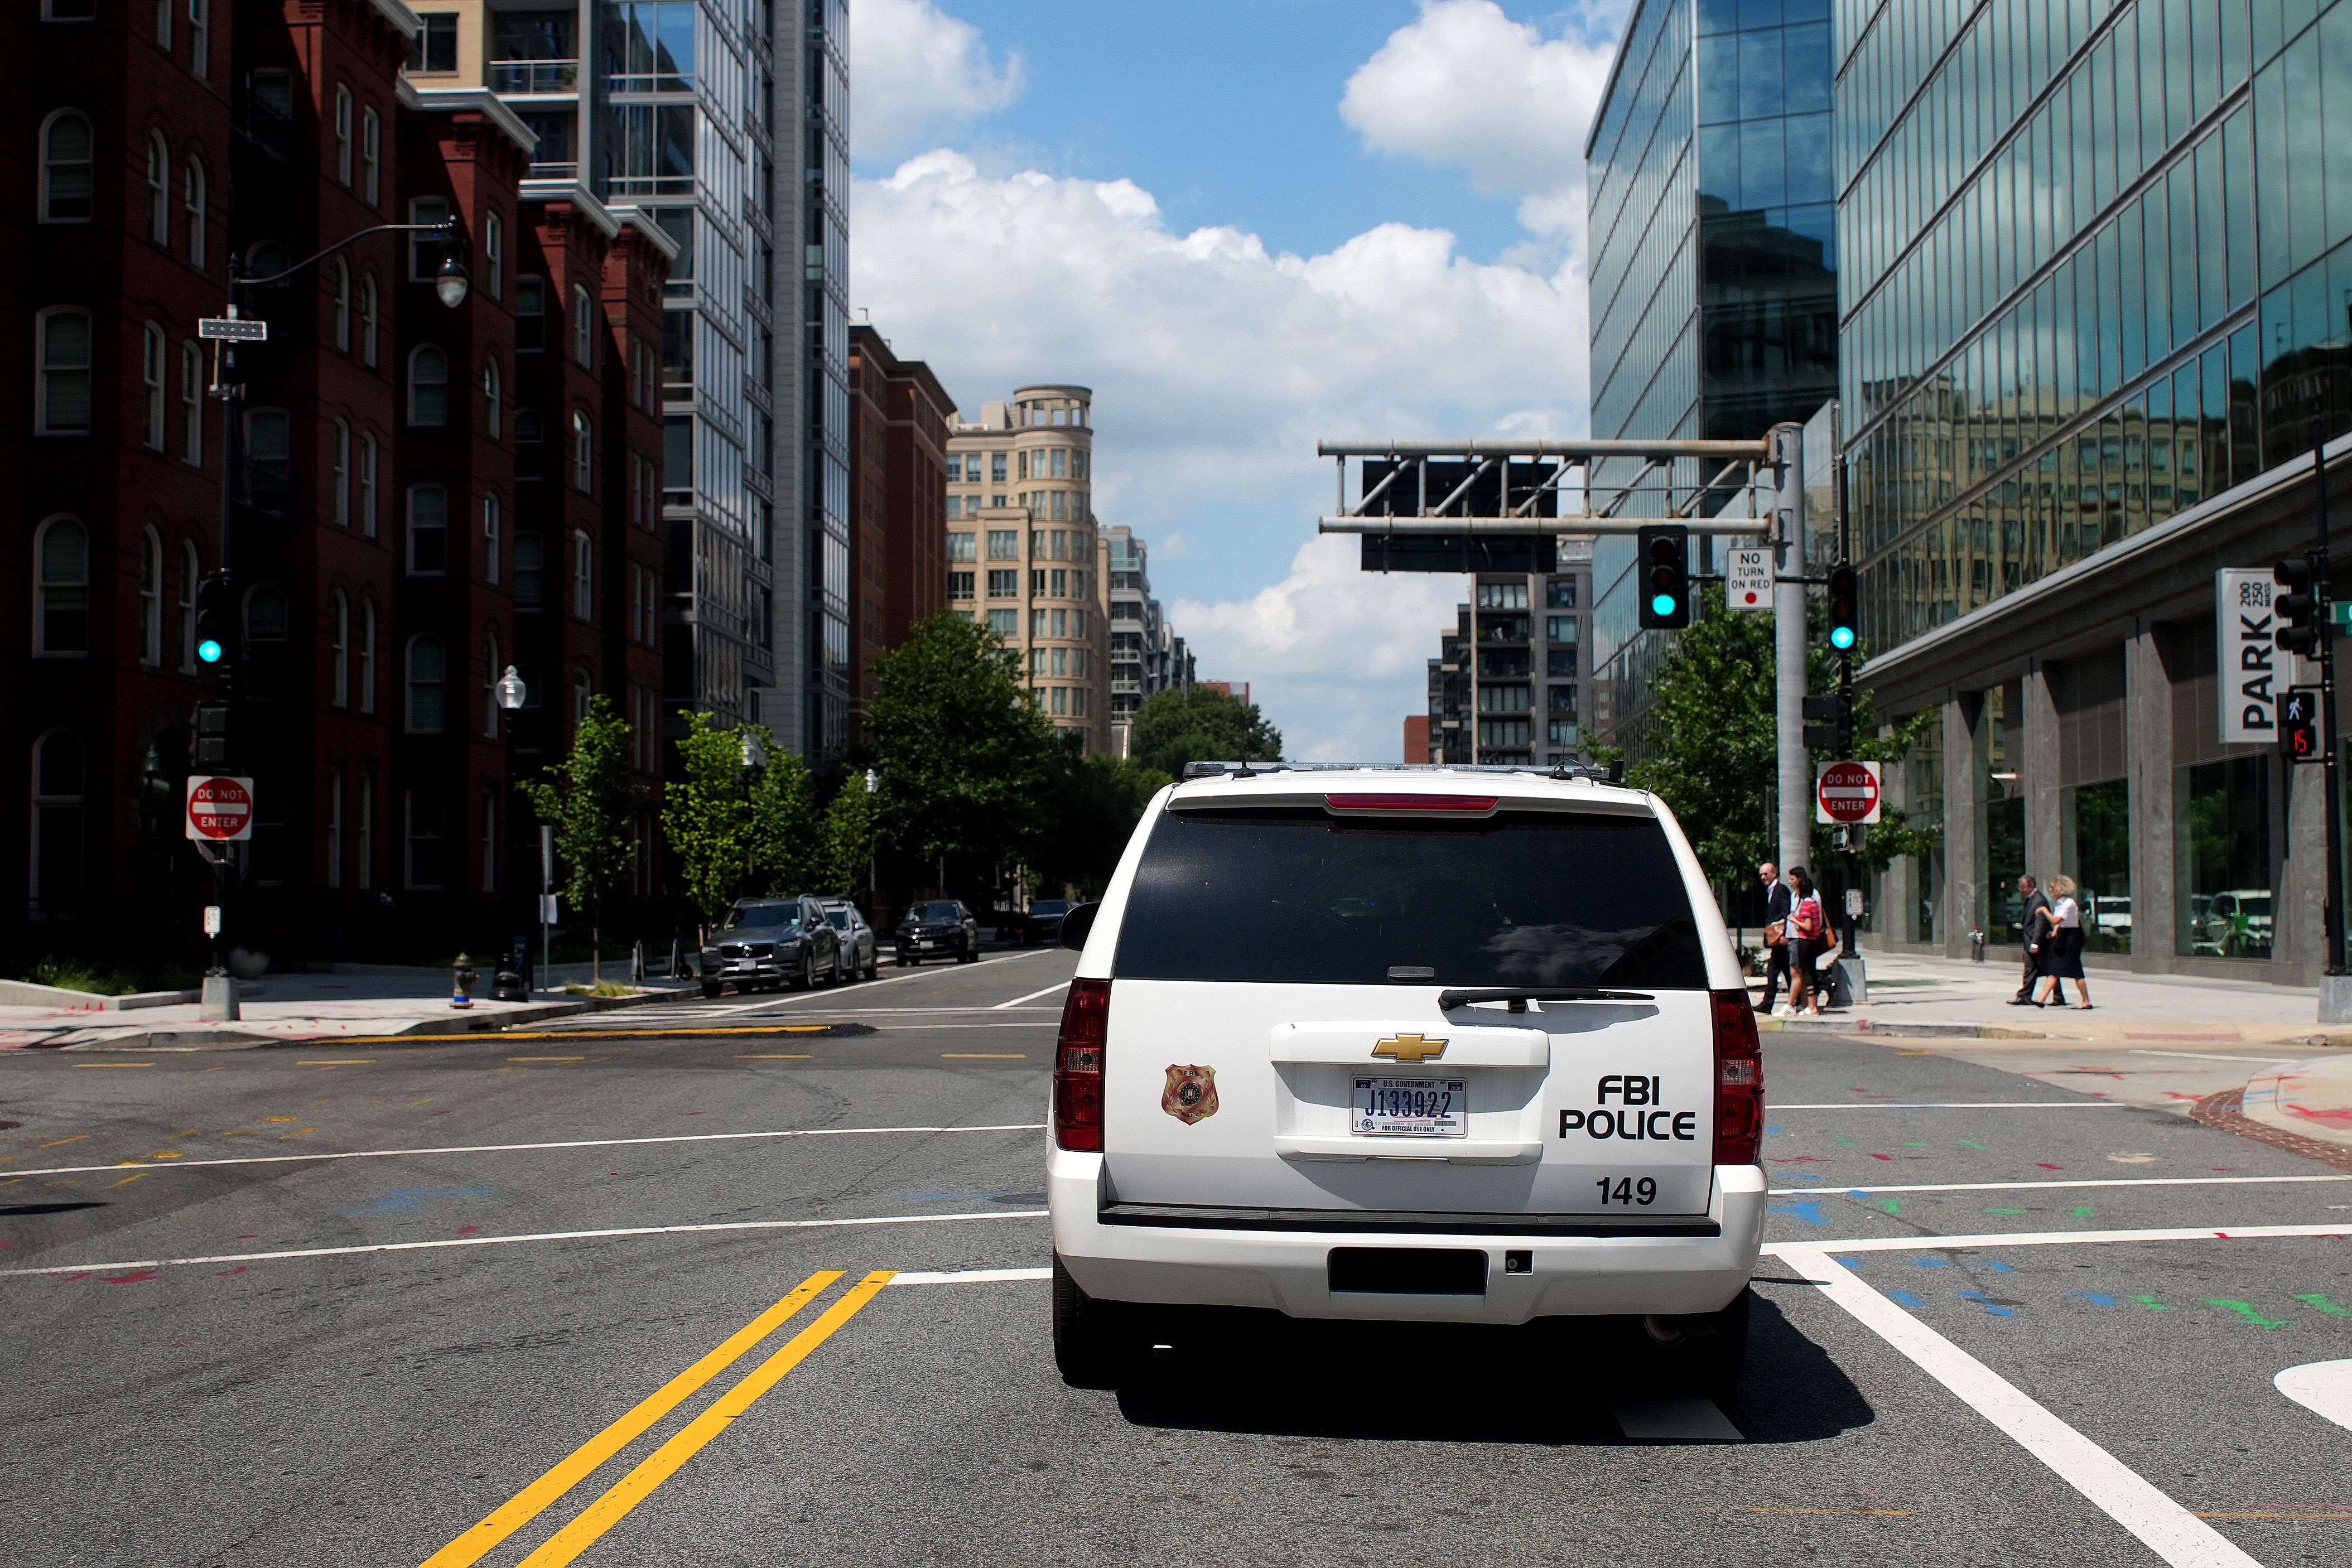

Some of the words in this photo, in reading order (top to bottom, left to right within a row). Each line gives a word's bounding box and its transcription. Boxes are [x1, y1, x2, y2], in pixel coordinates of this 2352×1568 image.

[1741, 553, 1760, 563] NO
[1738, 567, 1765, 576] TURN
[1732, 580, 1746, 590] ON
[1751, 580, 1770, 589] RED
[2240, 582, 2250, 606] 200
[2252, 582, 2263, 606] 250
[2241, 614, 2274, 729] PARK
[2295, 729, 2307, 752] 15
[1827, 774, 1842, 784] DO
[1847, 774, 1870, 784] NOT
[197, 788, 214, 799] DO
[220, 789, 244, 800] NOT
[1832, 800, 1866, 811] ENTER
[200, 816, 239, 828] ENTER
[1597, 1075, 1659, 1106] FBI
[1365, 1089, 1451, 1118] J133922
[1559, 1109, 1695, 1140] POLICE
[1596, 1176, 1657, 1205] 149
